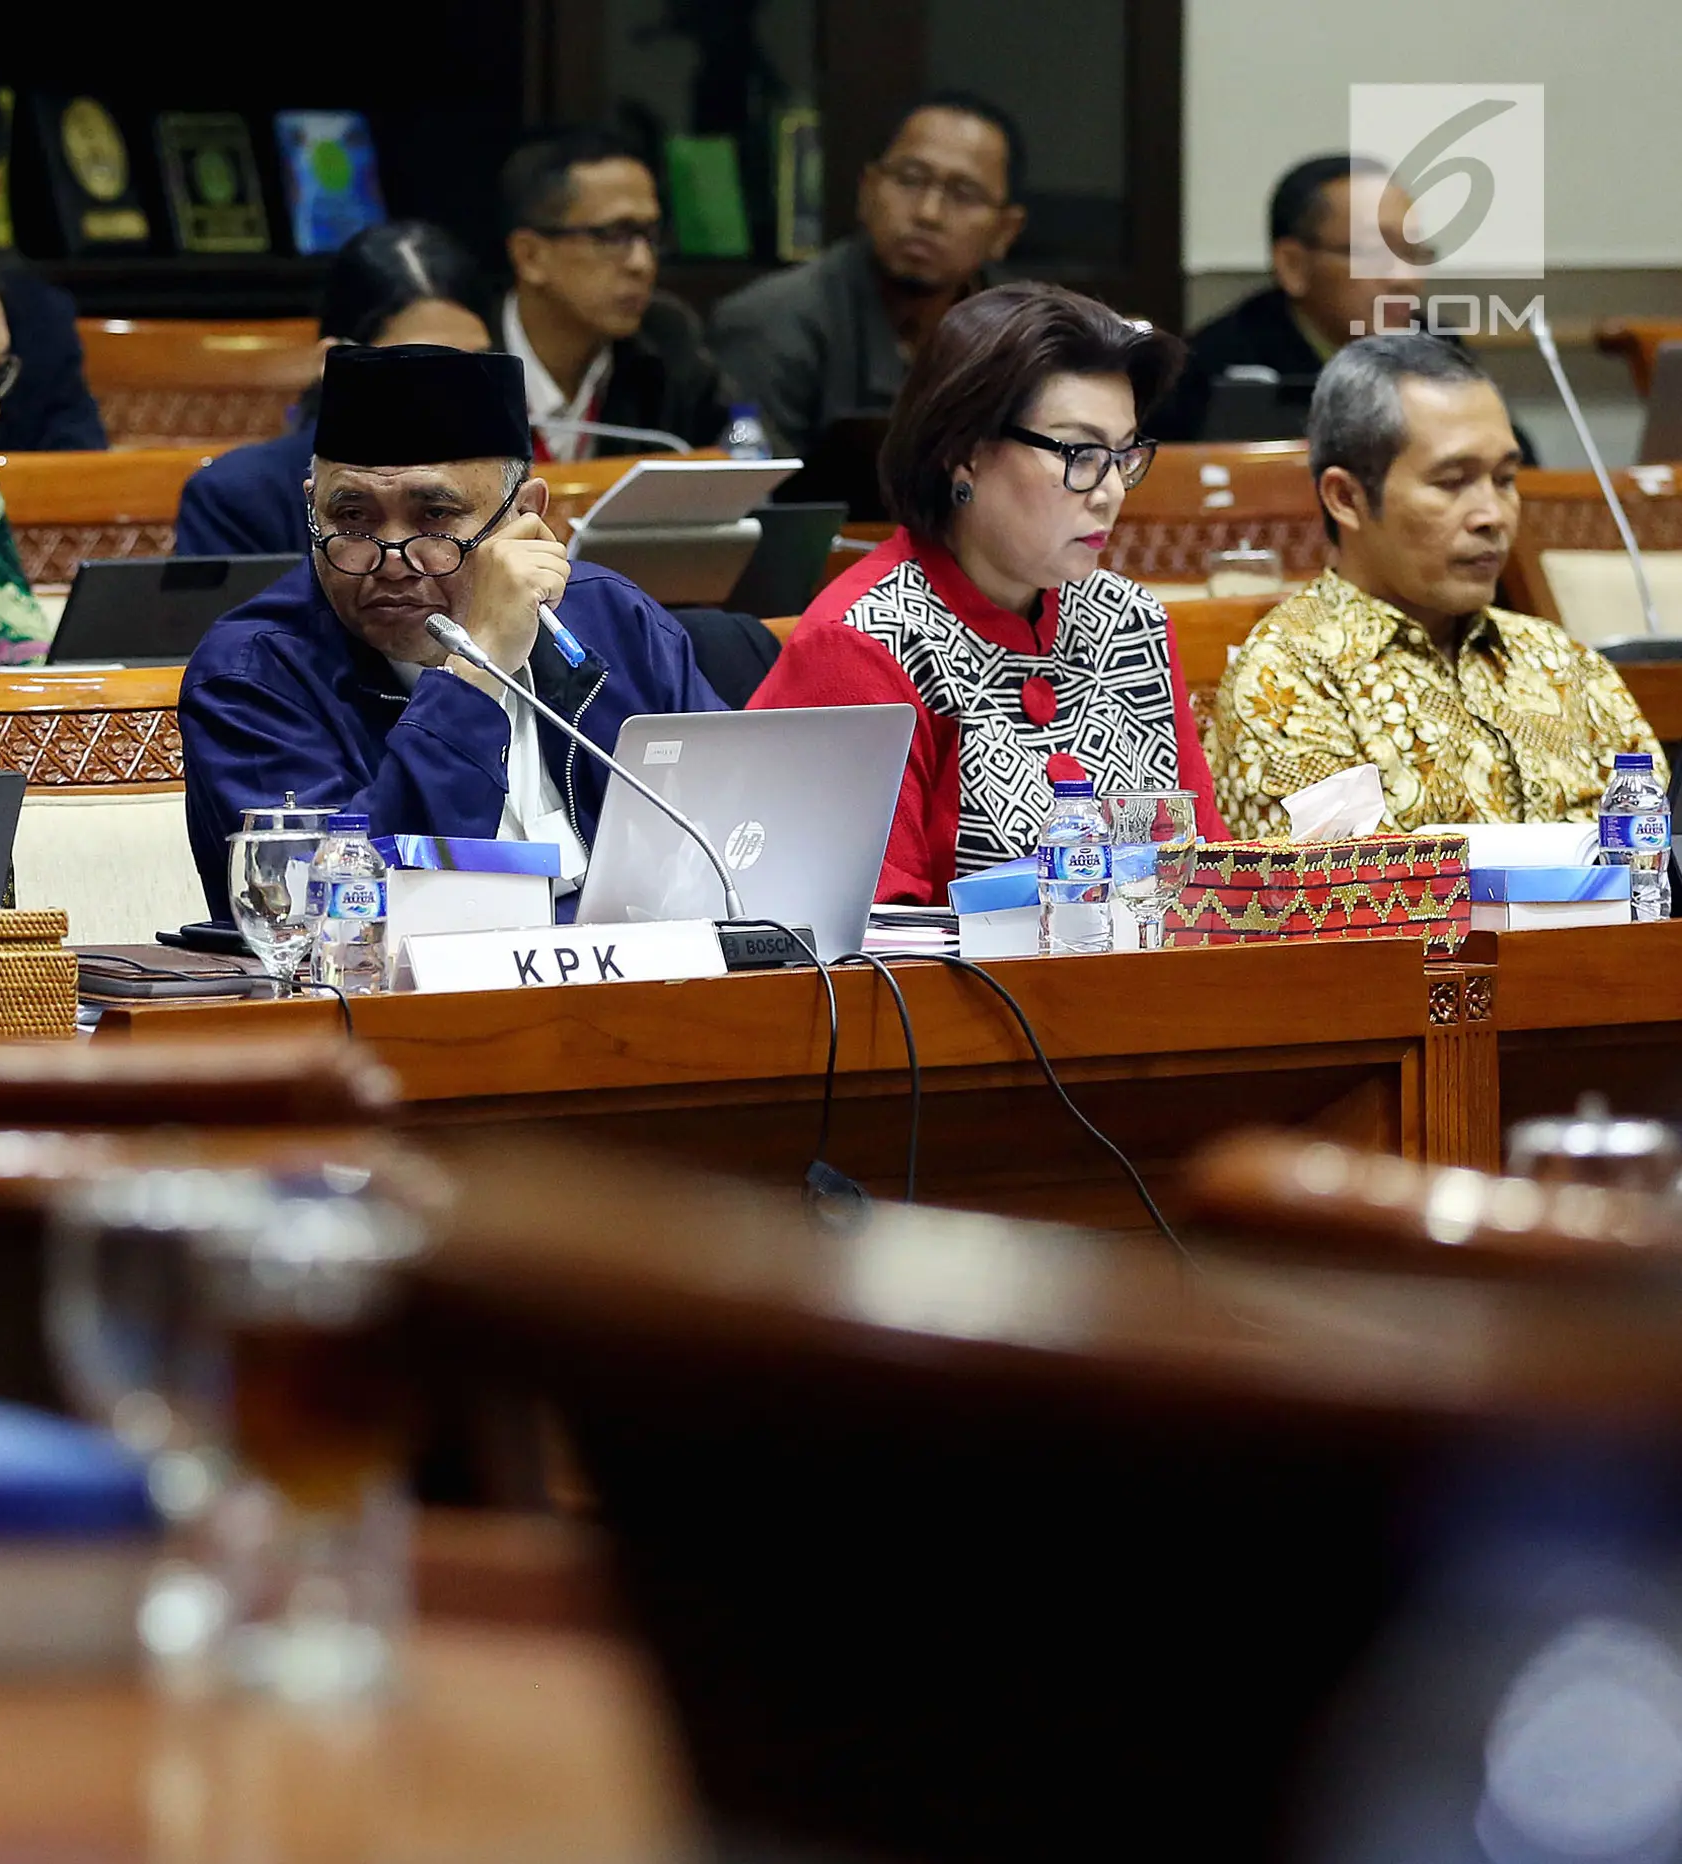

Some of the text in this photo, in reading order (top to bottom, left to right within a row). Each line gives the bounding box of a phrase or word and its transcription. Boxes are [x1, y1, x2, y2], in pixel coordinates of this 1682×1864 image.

[1636, 823, 1664, 836] AQUA
[1069, 853, 1101, 868] AQUA
[342, 891, 376, 905] AQUA
[746, 937, 797, 955] BOSCH
